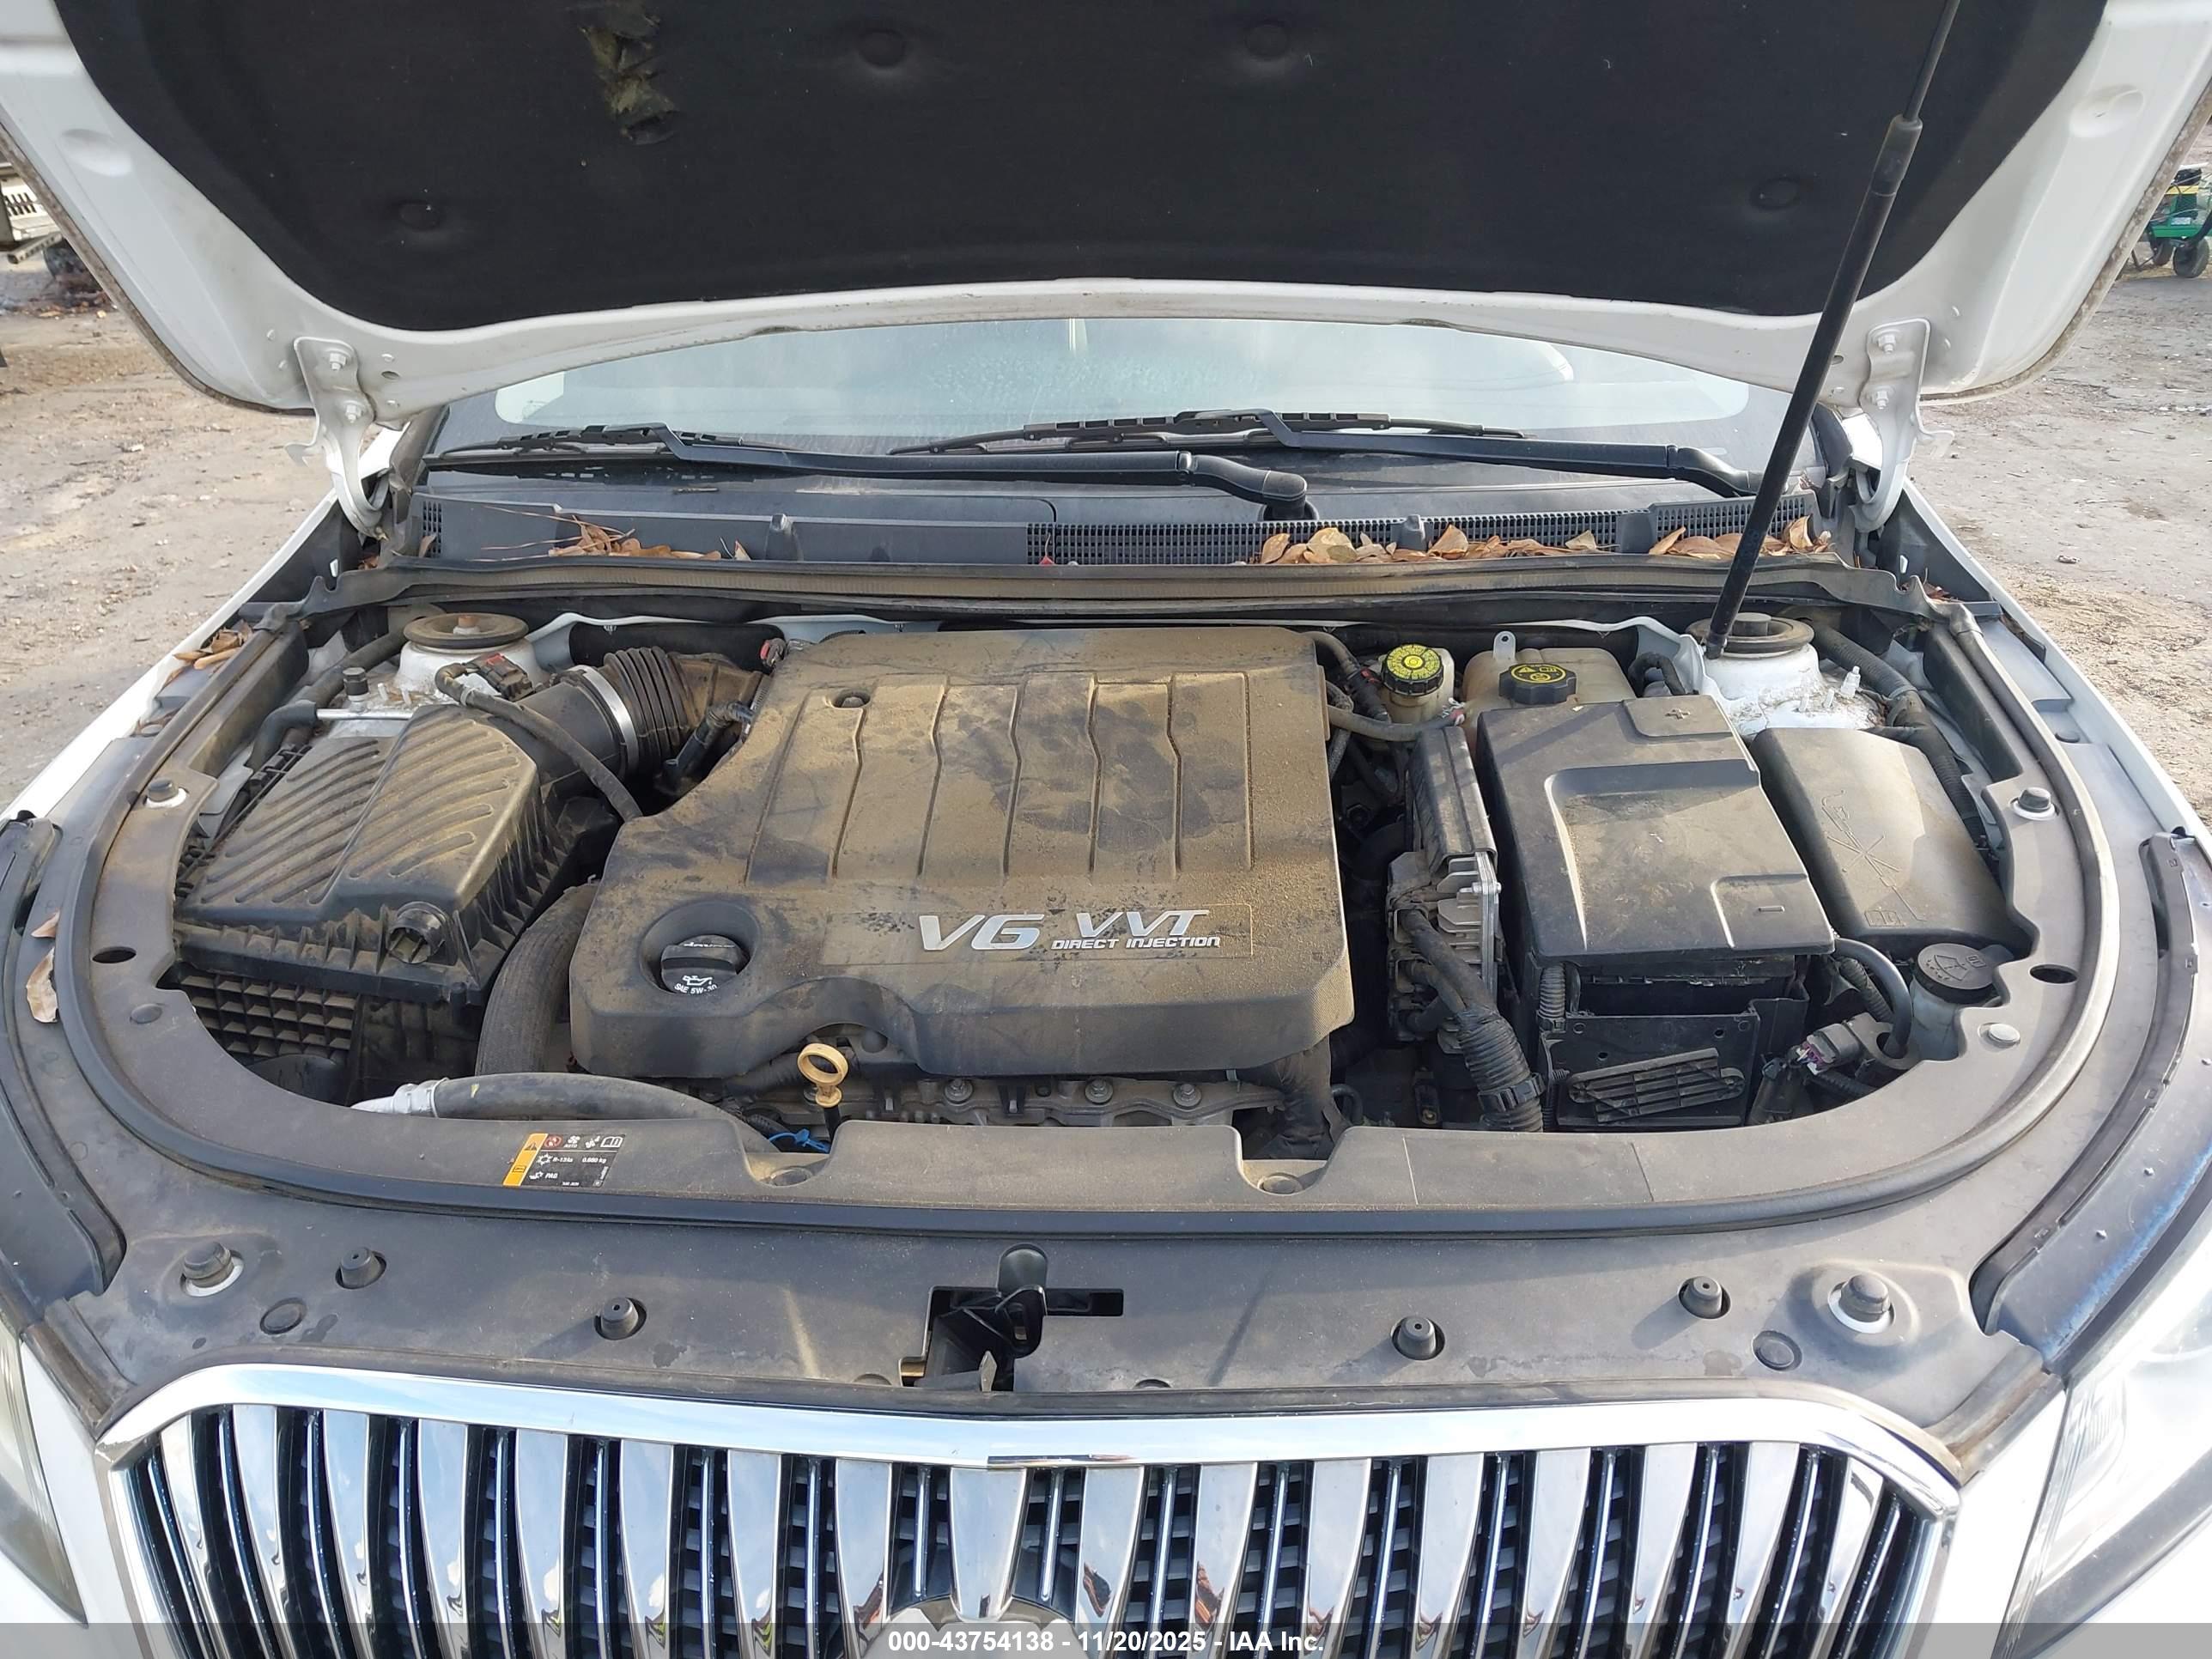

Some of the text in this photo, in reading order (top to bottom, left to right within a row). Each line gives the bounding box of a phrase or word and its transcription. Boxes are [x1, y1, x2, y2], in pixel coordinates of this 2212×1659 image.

[919, 909, 1210, 951] V6 VVT
[1050, 936, 1220, 951] DIRECT INJECTION
[674, 983, 718, 994] SAE 5W-30
